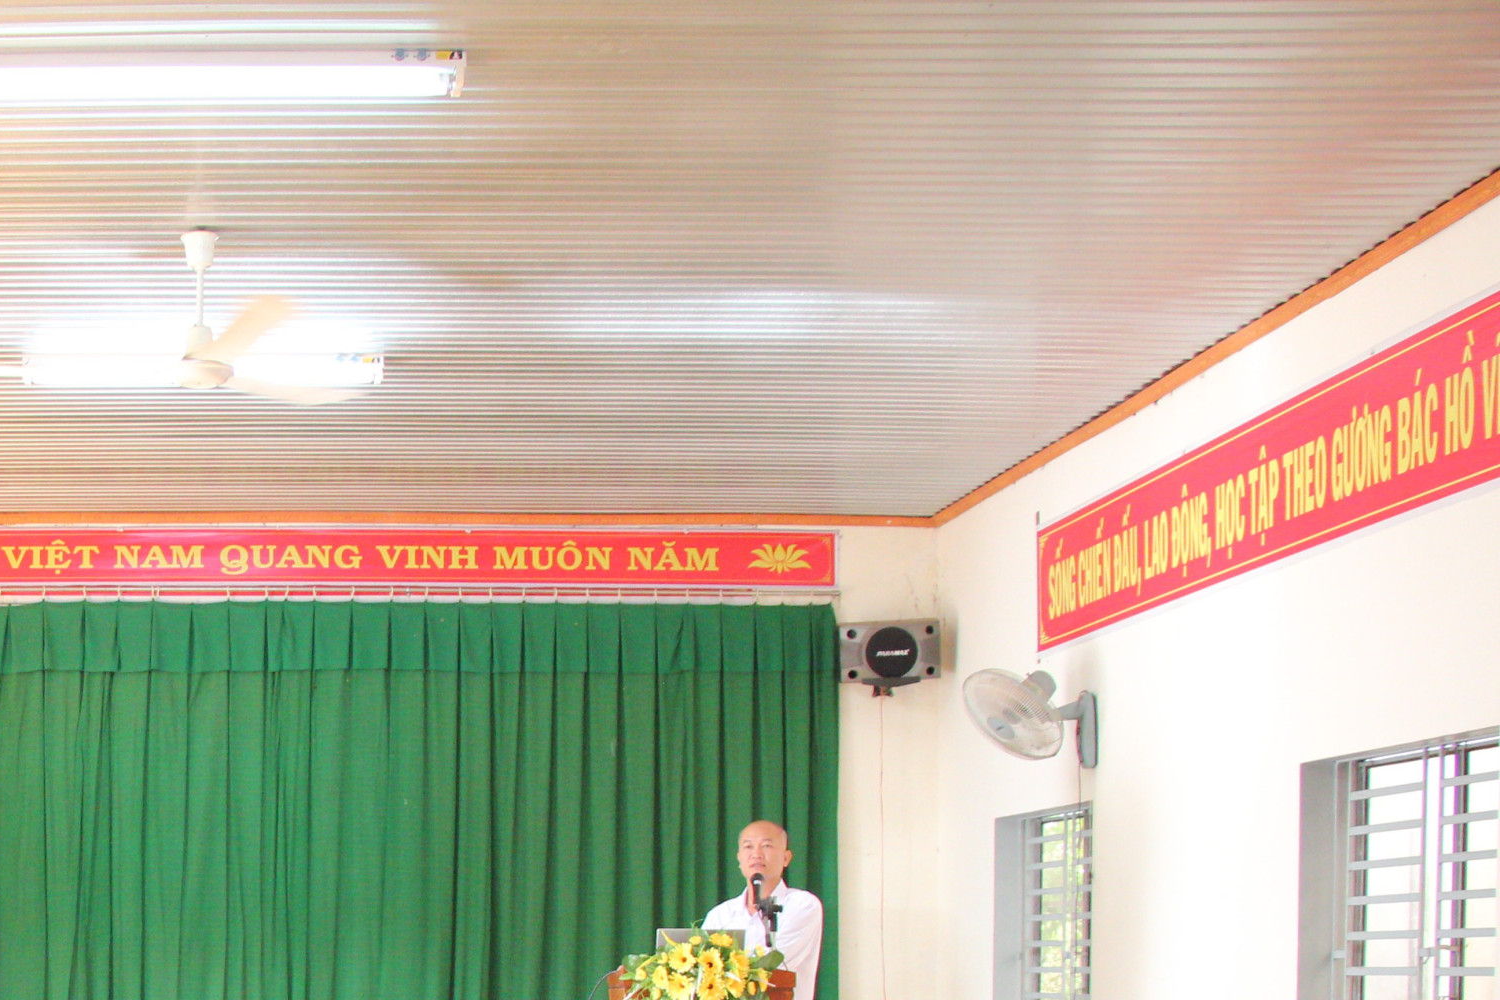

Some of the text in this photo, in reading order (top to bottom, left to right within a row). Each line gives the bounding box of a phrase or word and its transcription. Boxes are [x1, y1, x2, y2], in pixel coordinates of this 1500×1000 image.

[0, 539, 100, 575] VIỆT
[113, 545, 204, 570] NAM
[219, 544, 363, 576] QUANG
[376, 545, 480, 570] VINH
[492, 540, 613, 571] MUÔN
[627, 540, 720, 572] NĂM
[1048, 539, 1077, 621] SỐNG
[1078, 518, 1112, 608] CHIẾN
[1113, 504, 1142, 597] ĐẤU,
[1144, 510, 1169, 581] LAO
[1171, 483, 1212, 578] ĐỘNG,
[1215, 479, 1246, 560] HỌC
[1248, 445, 1280, 546] TẬP
[1283, 435, 1327, 522] THEO
[1331, 403, 1393, 503] GƯƠNG
[1397, 368, 1439, 476] BÁC
[1445, 330, 1475, 457] HỒ
